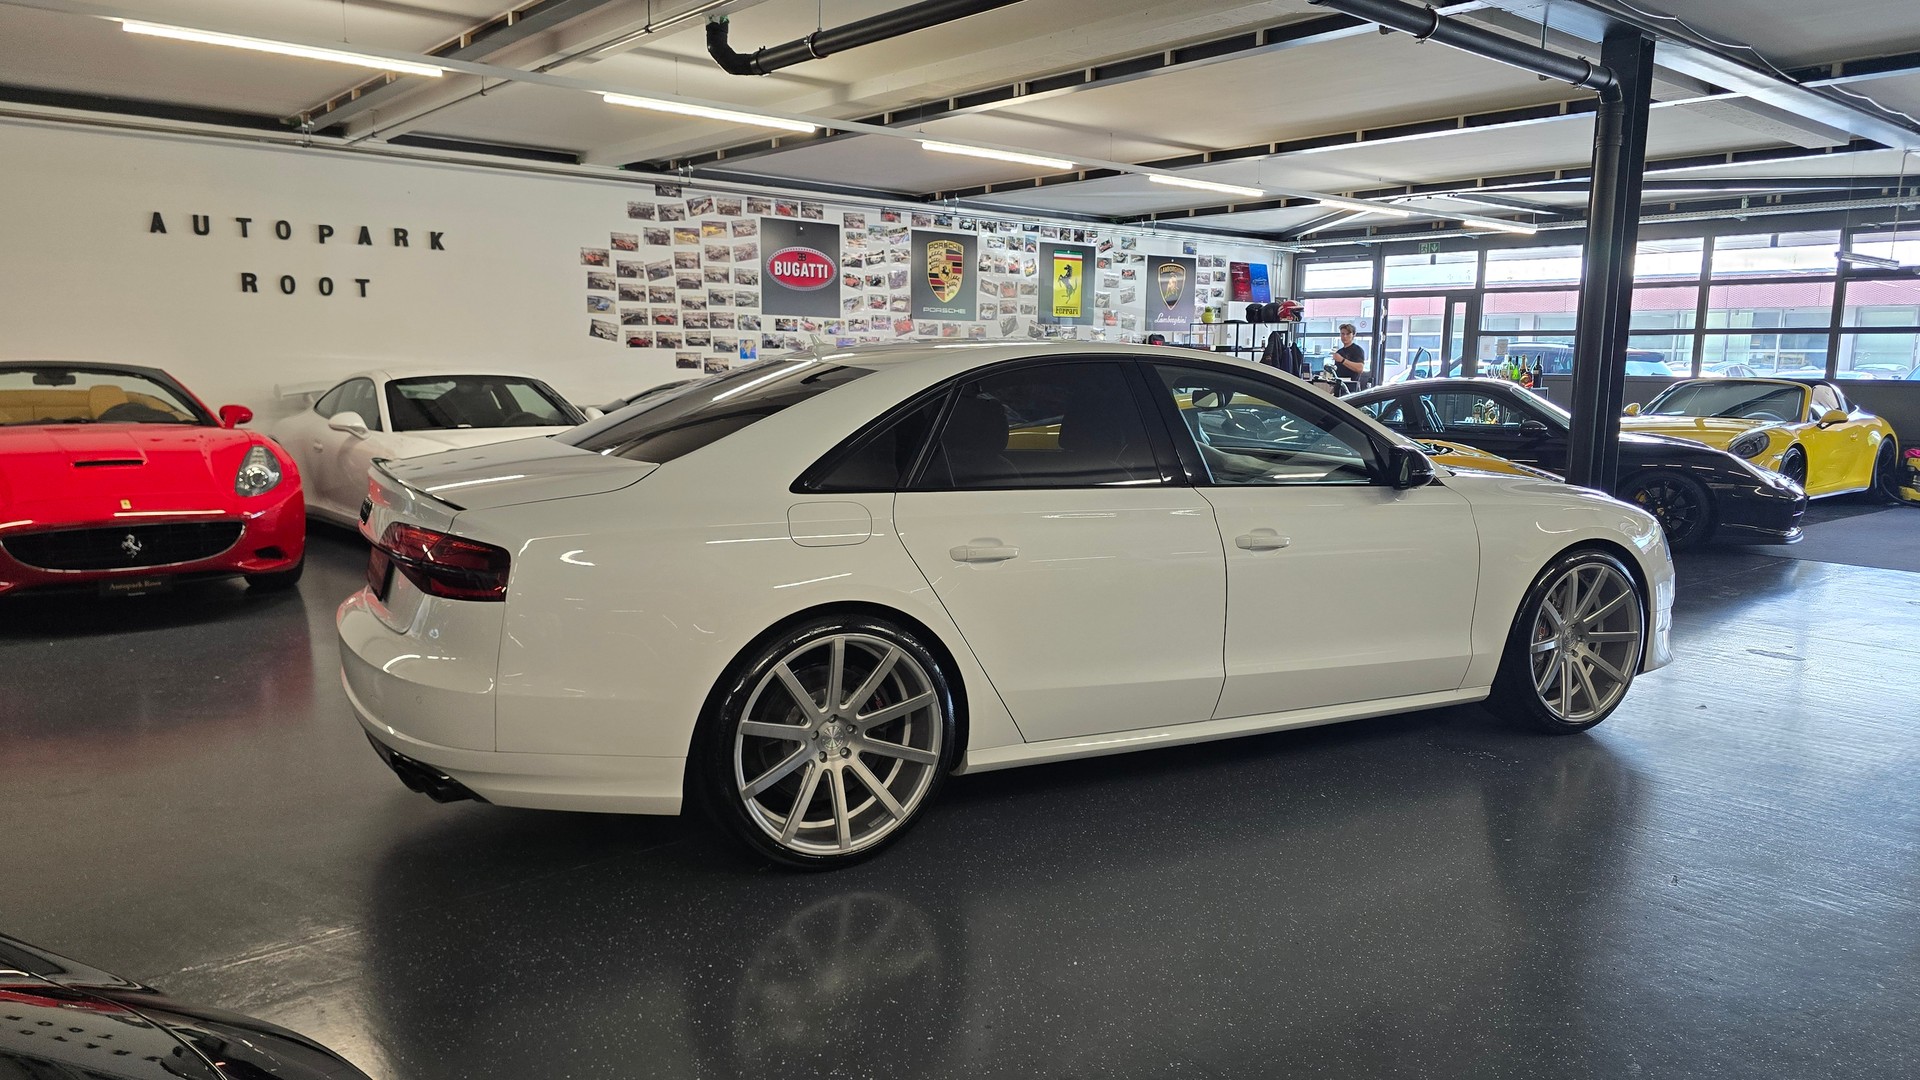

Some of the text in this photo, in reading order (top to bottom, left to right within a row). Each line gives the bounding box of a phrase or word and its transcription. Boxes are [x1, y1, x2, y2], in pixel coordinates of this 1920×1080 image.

[150, 212, 445, 250] AUTOPARK
[928, 242, 963, 253] PORSCHE
[774, 260, 828, 279] BUGATTI
[241, 272, 370, 298] ROOT
[922, 306, 967, 315] PORSCHE
[1055, 305, 1079, 315] Ferrari
[1154, 312, 1188, 326] Lamborghini
